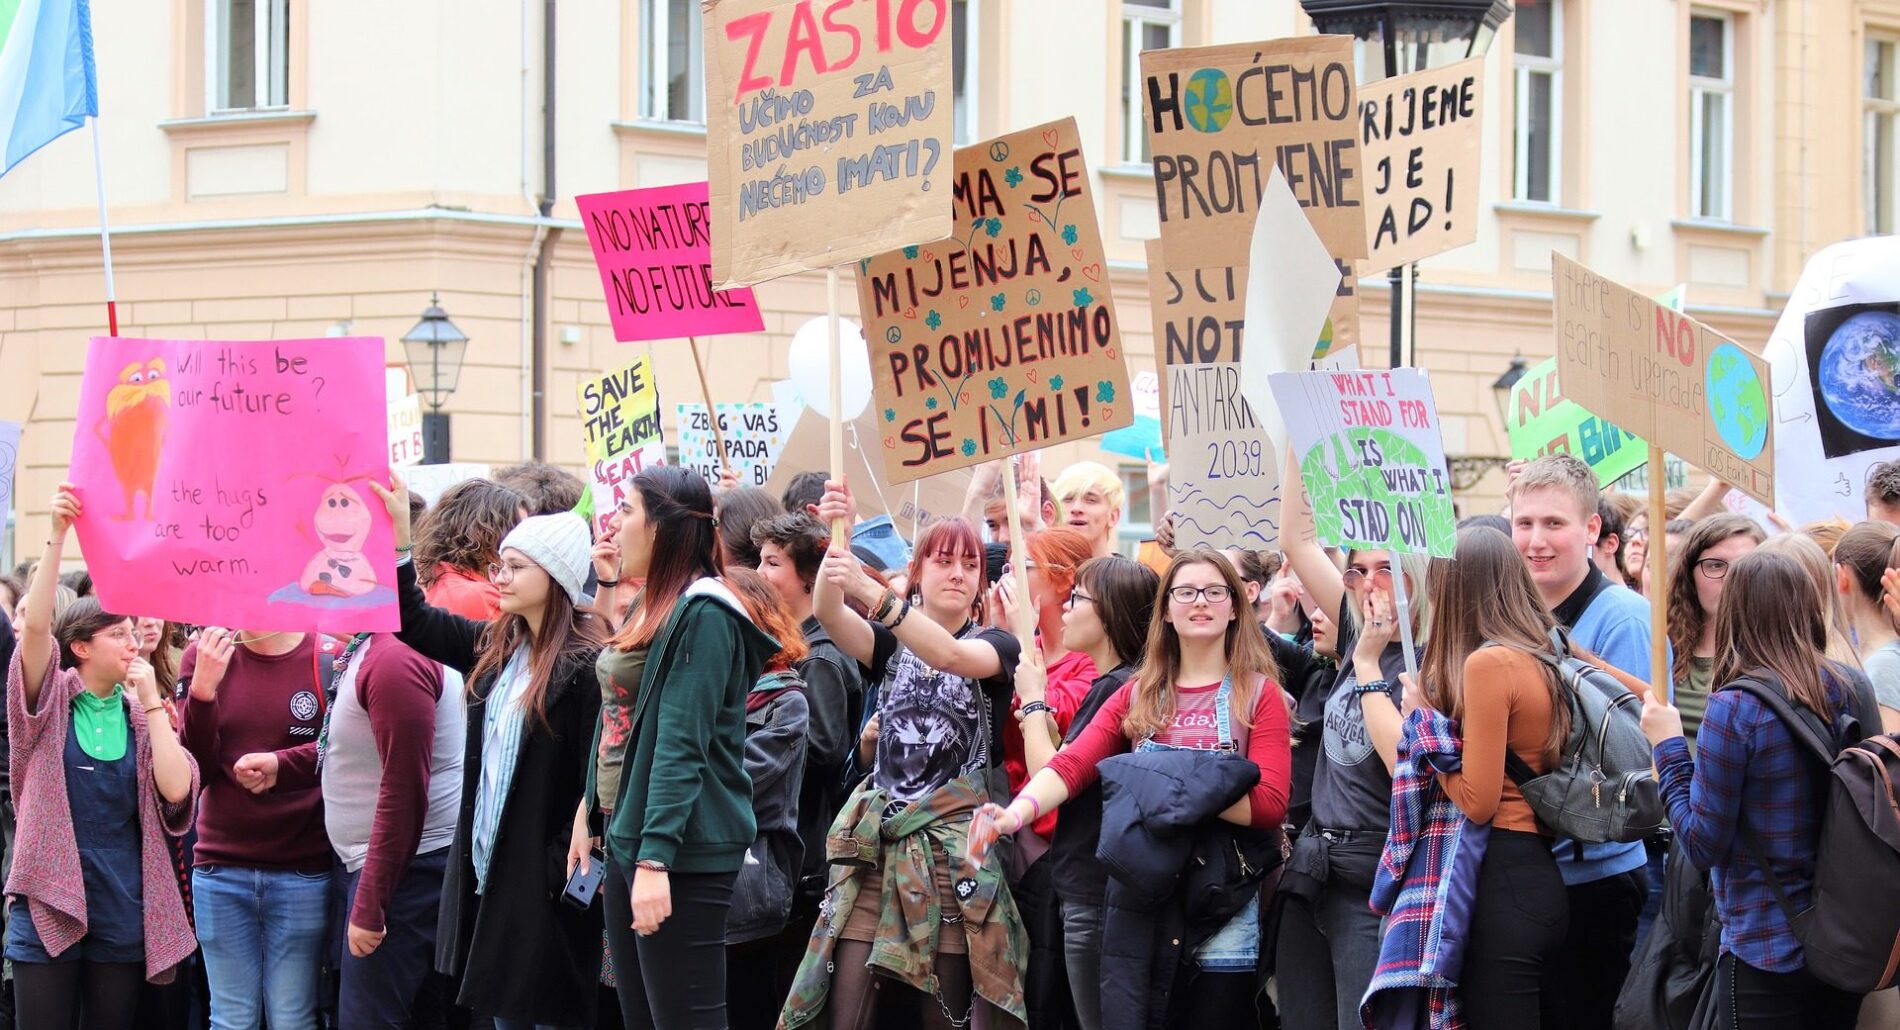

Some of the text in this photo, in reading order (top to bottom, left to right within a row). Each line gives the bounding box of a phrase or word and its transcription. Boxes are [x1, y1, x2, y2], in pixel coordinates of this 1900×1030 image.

[739, 65, 894, 134] UČIMO ZA
[742, 91, 935, 171] BUDUĆNOST KOJU
[739, 138, 940, 222] NEĆEMO IMATI?
[952, 148, 1082, 220] MA SE
[1375, 146, 1423, 195] JE
[591, 209, 631, 252] NO
[610, 267, 649, 316] NO
[872, 233, 1072, 318] MIJENJA,
[1565, 263, 1610, 319] there
[1656, 305, 1695, 368] NO
[218, 349, 257, 377] this
[275, 347, 308, 375] be
[889, 305, 1112, 397] PROMIJENIMO
[1166, 315, 1245, 365] NOT
[584, 361, 644, 415] SAVE
[1330, 373, 1395, 397] WHAT I
[1564, 320, 1702, 415] earth upgrade
[178, 390, 202, 407] our
[210, 382, 292, 415] future
[743, 408, 780, 432] VAŠ
[1341, 399, 1431, 429] STAND FOR
[585, 404, 623, 443] THE
[606, 411, 660, 457] EARTH
[901, 386, 1091, 467] SE I MI!
[606, 447, 644, 487] EAT
[1208, 439, 1266, 479] 2039.
[1357, 439, 1383, 467] IS
[172, 473, 267, 529] the hugs
[1380, 469, 1445, 494] WHAT I
[155, 514, 240, 541] are too
[1397, 501, 1427, 548] ON
[172, 556, 258, 575] warm.
